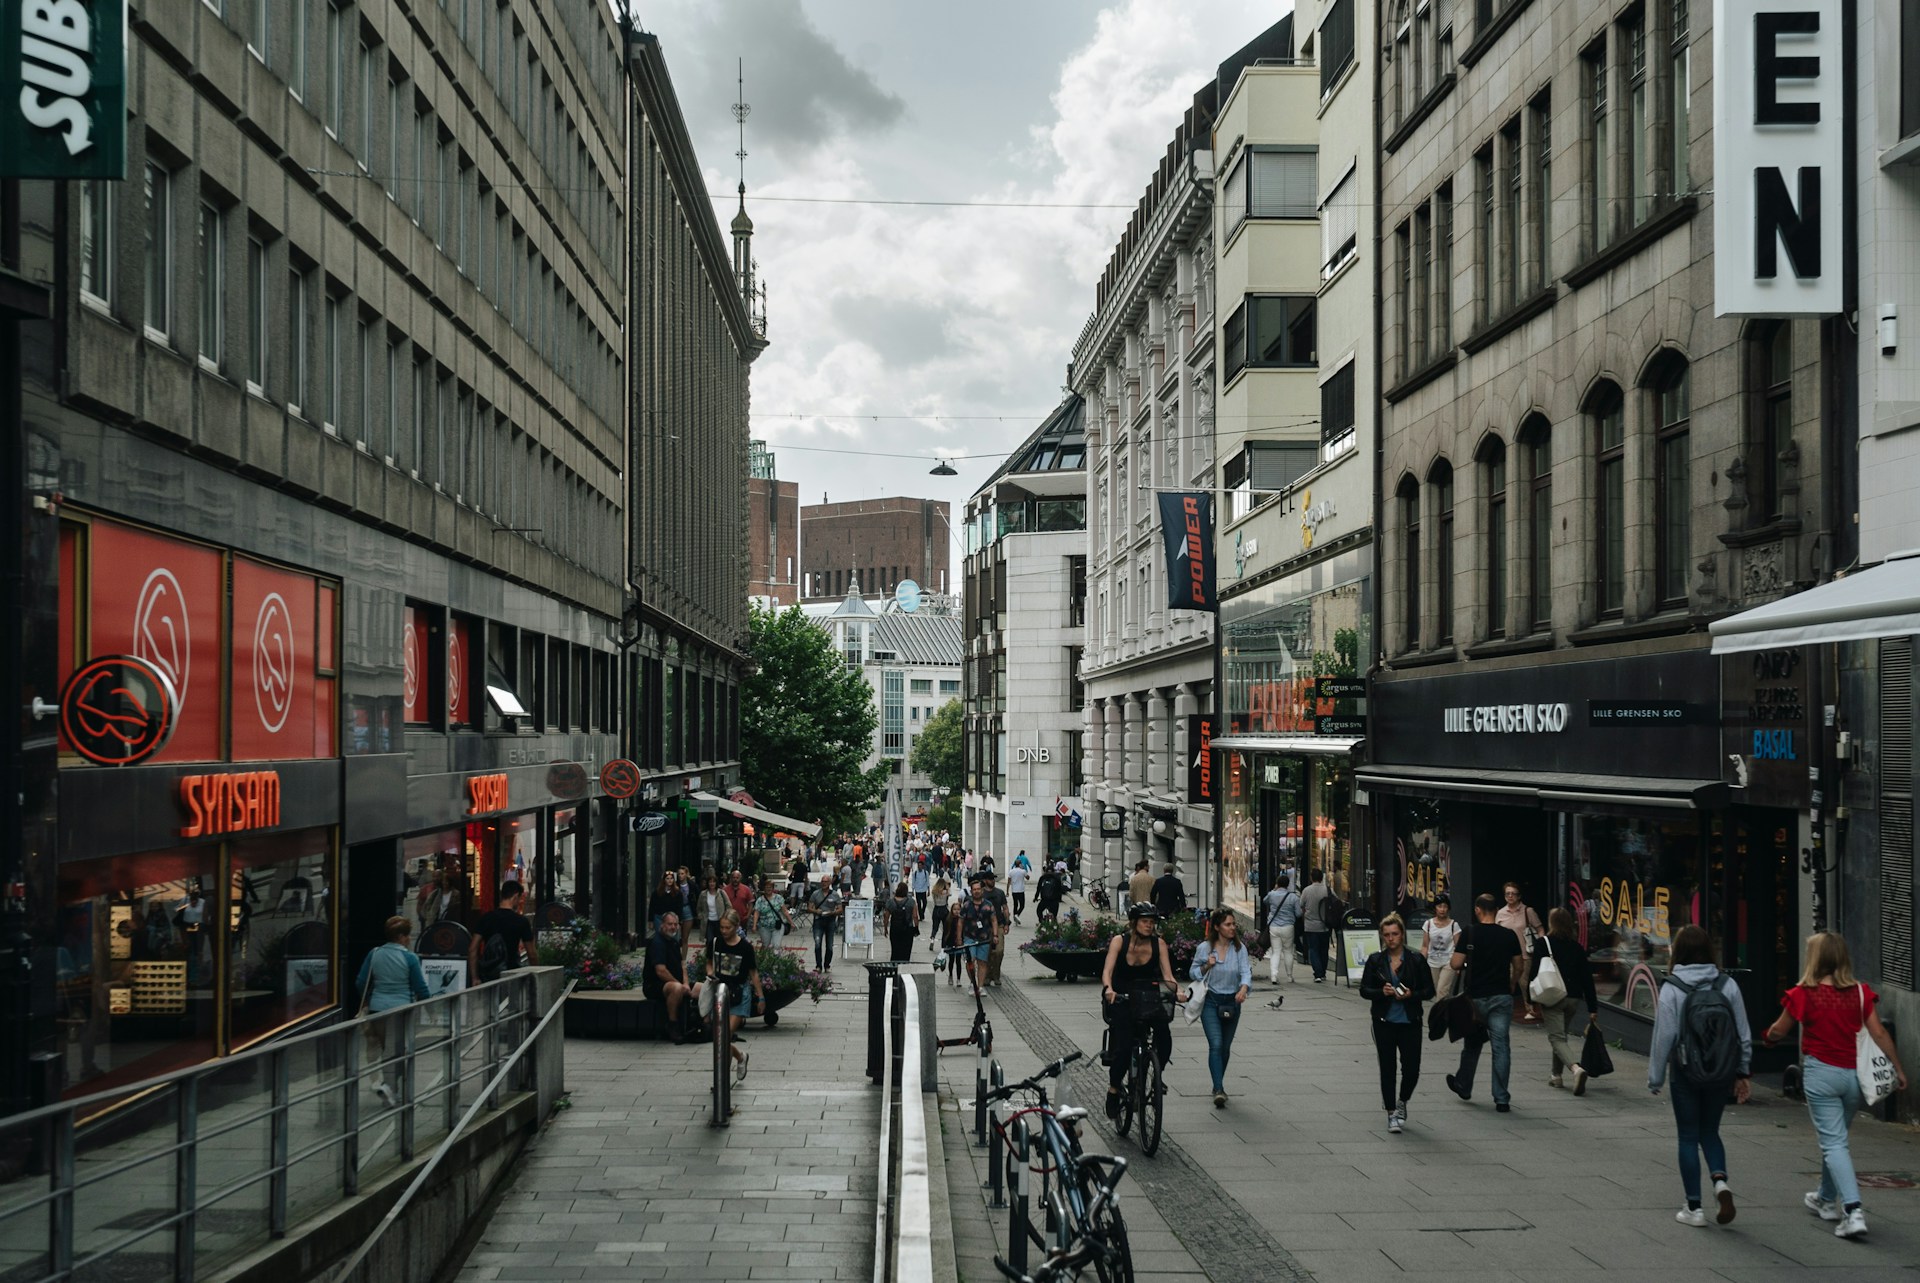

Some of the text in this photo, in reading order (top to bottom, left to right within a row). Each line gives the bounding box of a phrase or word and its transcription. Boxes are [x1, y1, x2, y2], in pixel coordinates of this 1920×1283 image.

[1183, 496, 1206, 605] POWER
[1326, 685, 1349, 693] argus
[1326, 722, 1349, 730] argus
[1444, 703, 1568, 733] LILLE GRENSEN SKO
[1593, 709, 1682, 718] LILLE GRENSEN SKO
[1201, 720, 1211, 797] POWER
[1753, 729, 1797, 760] BASAL
[180, 770, 281, 838] SYNSAM
[466, 773, 508, 815] SYNSAM
[1407, 861, 1444, 903] SALE
[1600, 875, 1670, 940] SALE
